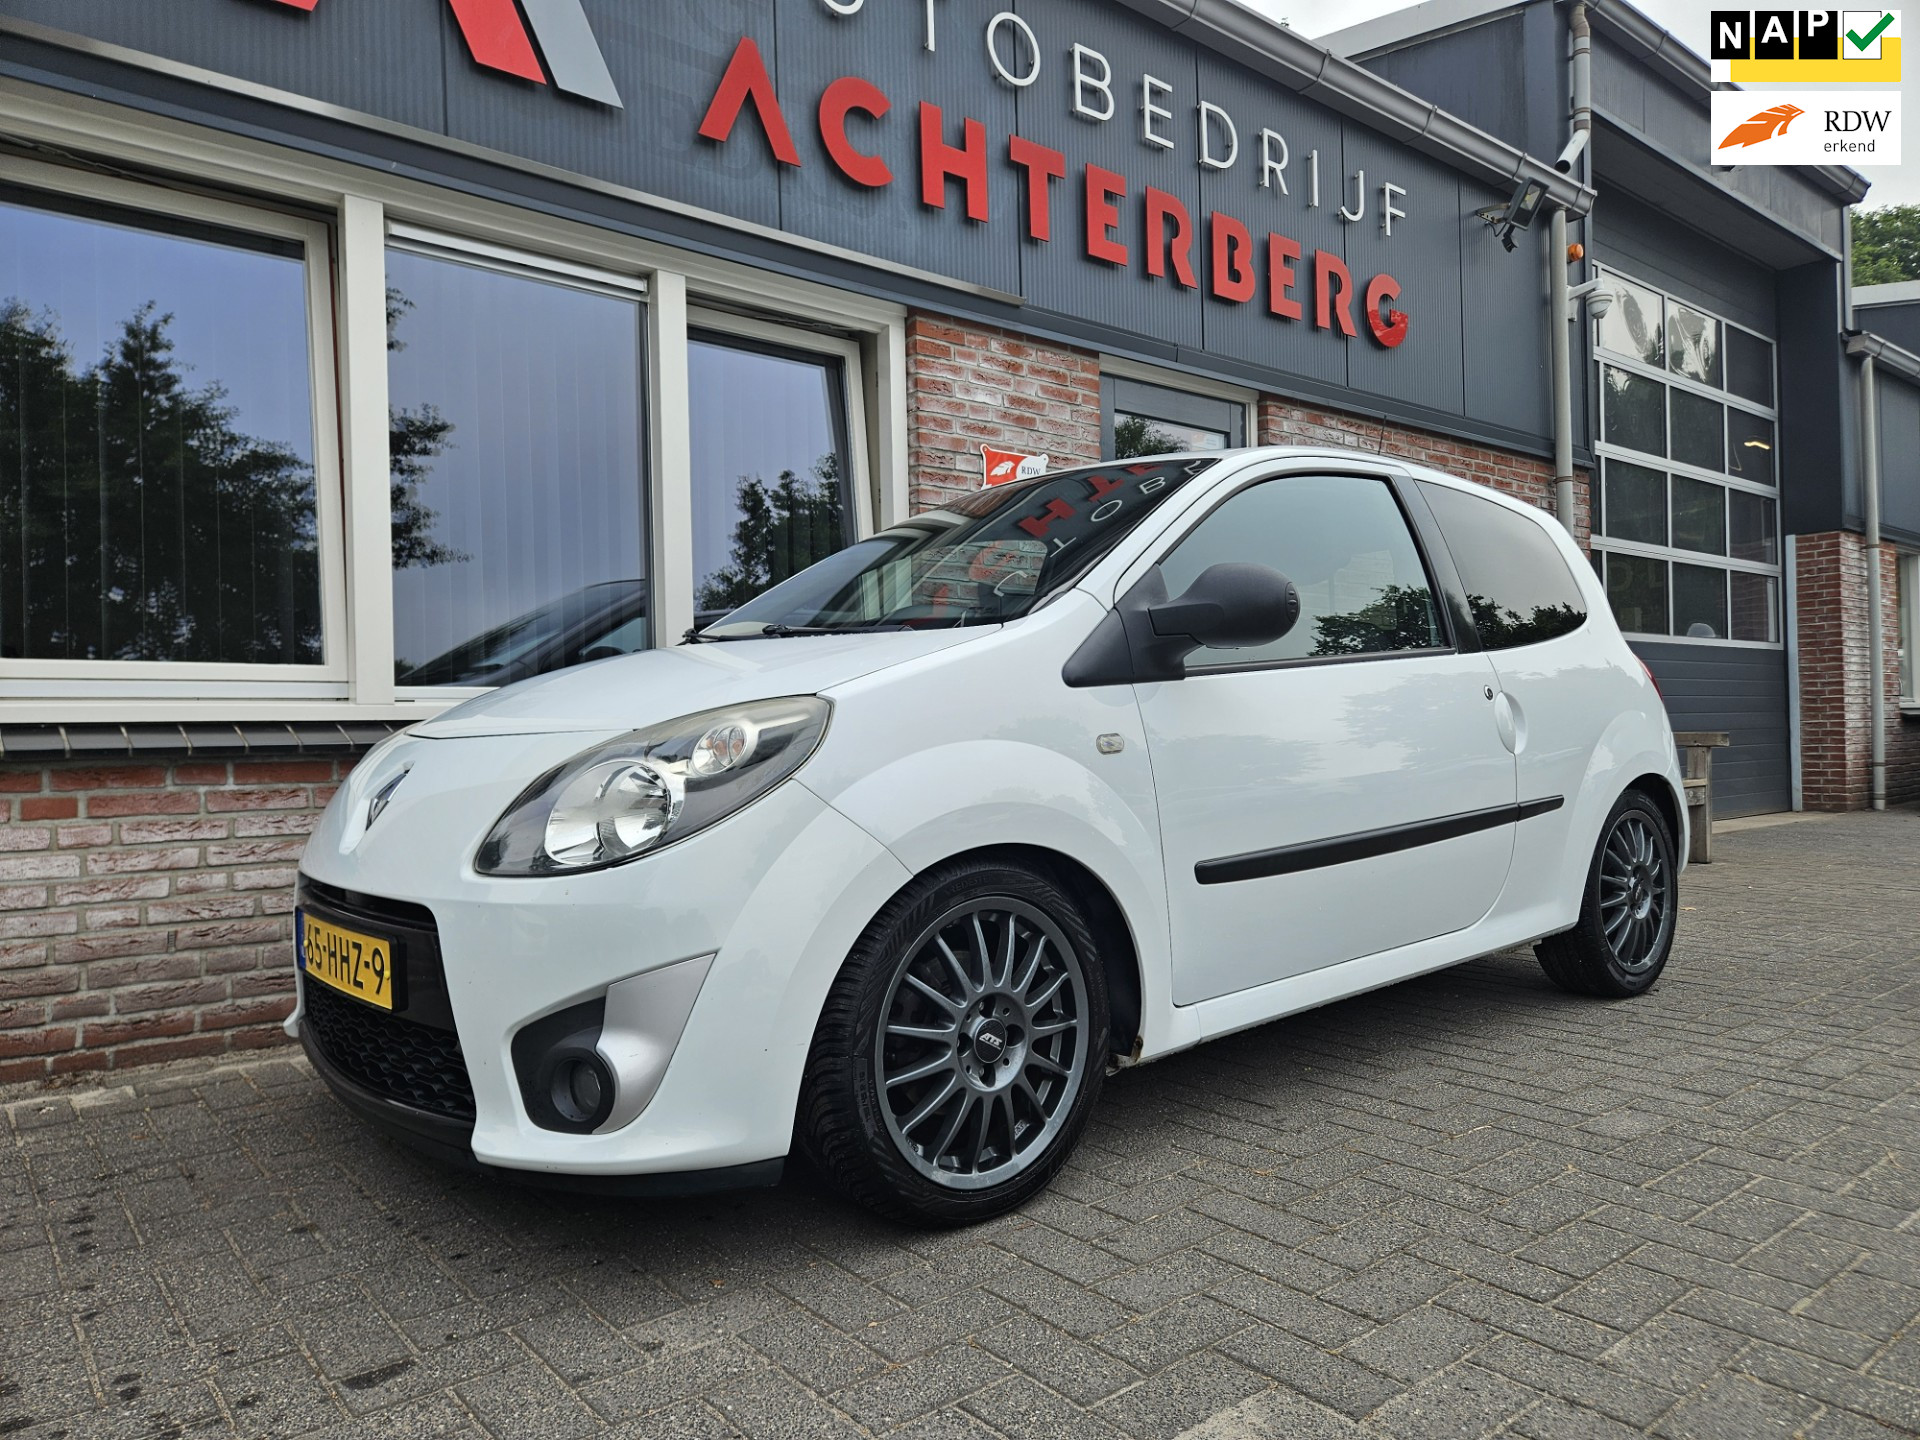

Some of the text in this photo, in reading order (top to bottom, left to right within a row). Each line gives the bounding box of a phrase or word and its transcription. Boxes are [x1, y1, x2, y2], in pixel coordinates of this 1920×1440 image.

[698, 36, 1409, 348] ACHTERBERG
[823, 0, 1407, 237] TOBEDRIJF
[1021, 466, 1041, 476] RDW
[306, 923, 385, 995] 65-HHZ-9
